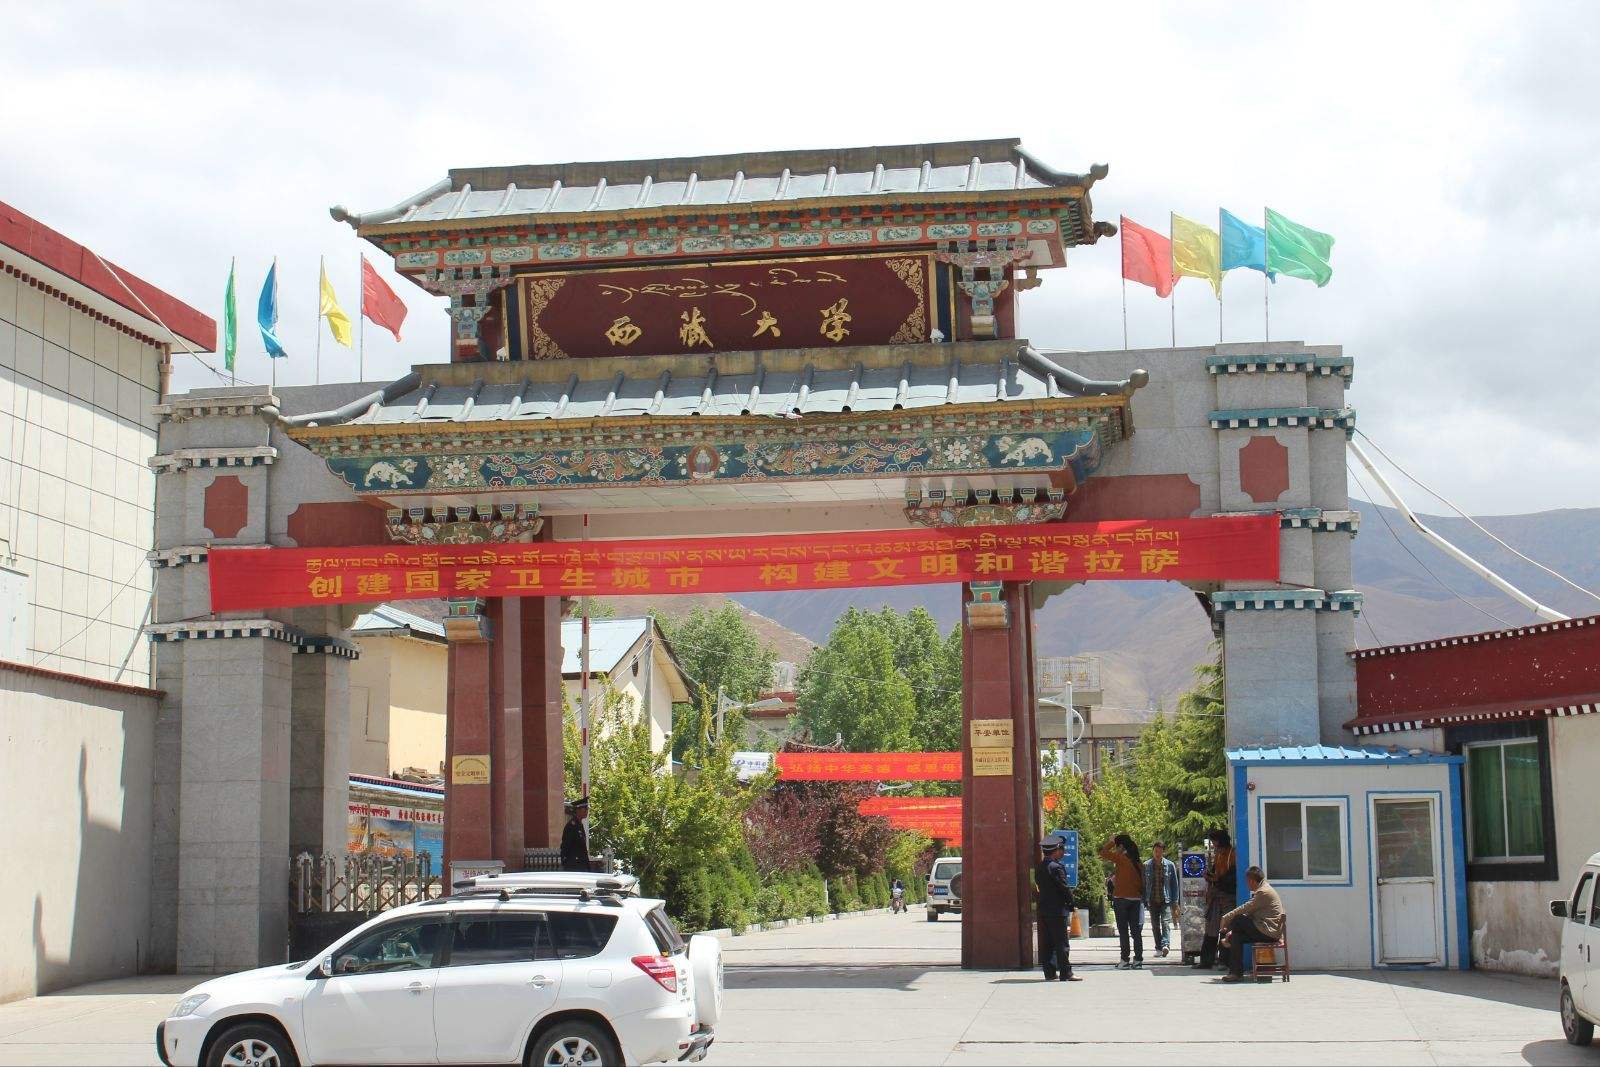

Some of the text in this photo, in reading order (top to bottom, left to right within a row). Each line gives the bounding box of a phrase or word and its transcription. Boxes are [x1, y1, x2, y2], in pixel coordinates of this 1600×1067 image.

[605, 298, 852, 348] 西藏大学
[308, 549, 1179, 599] 创建国家卫生城市 构建文明和谐拉萨
